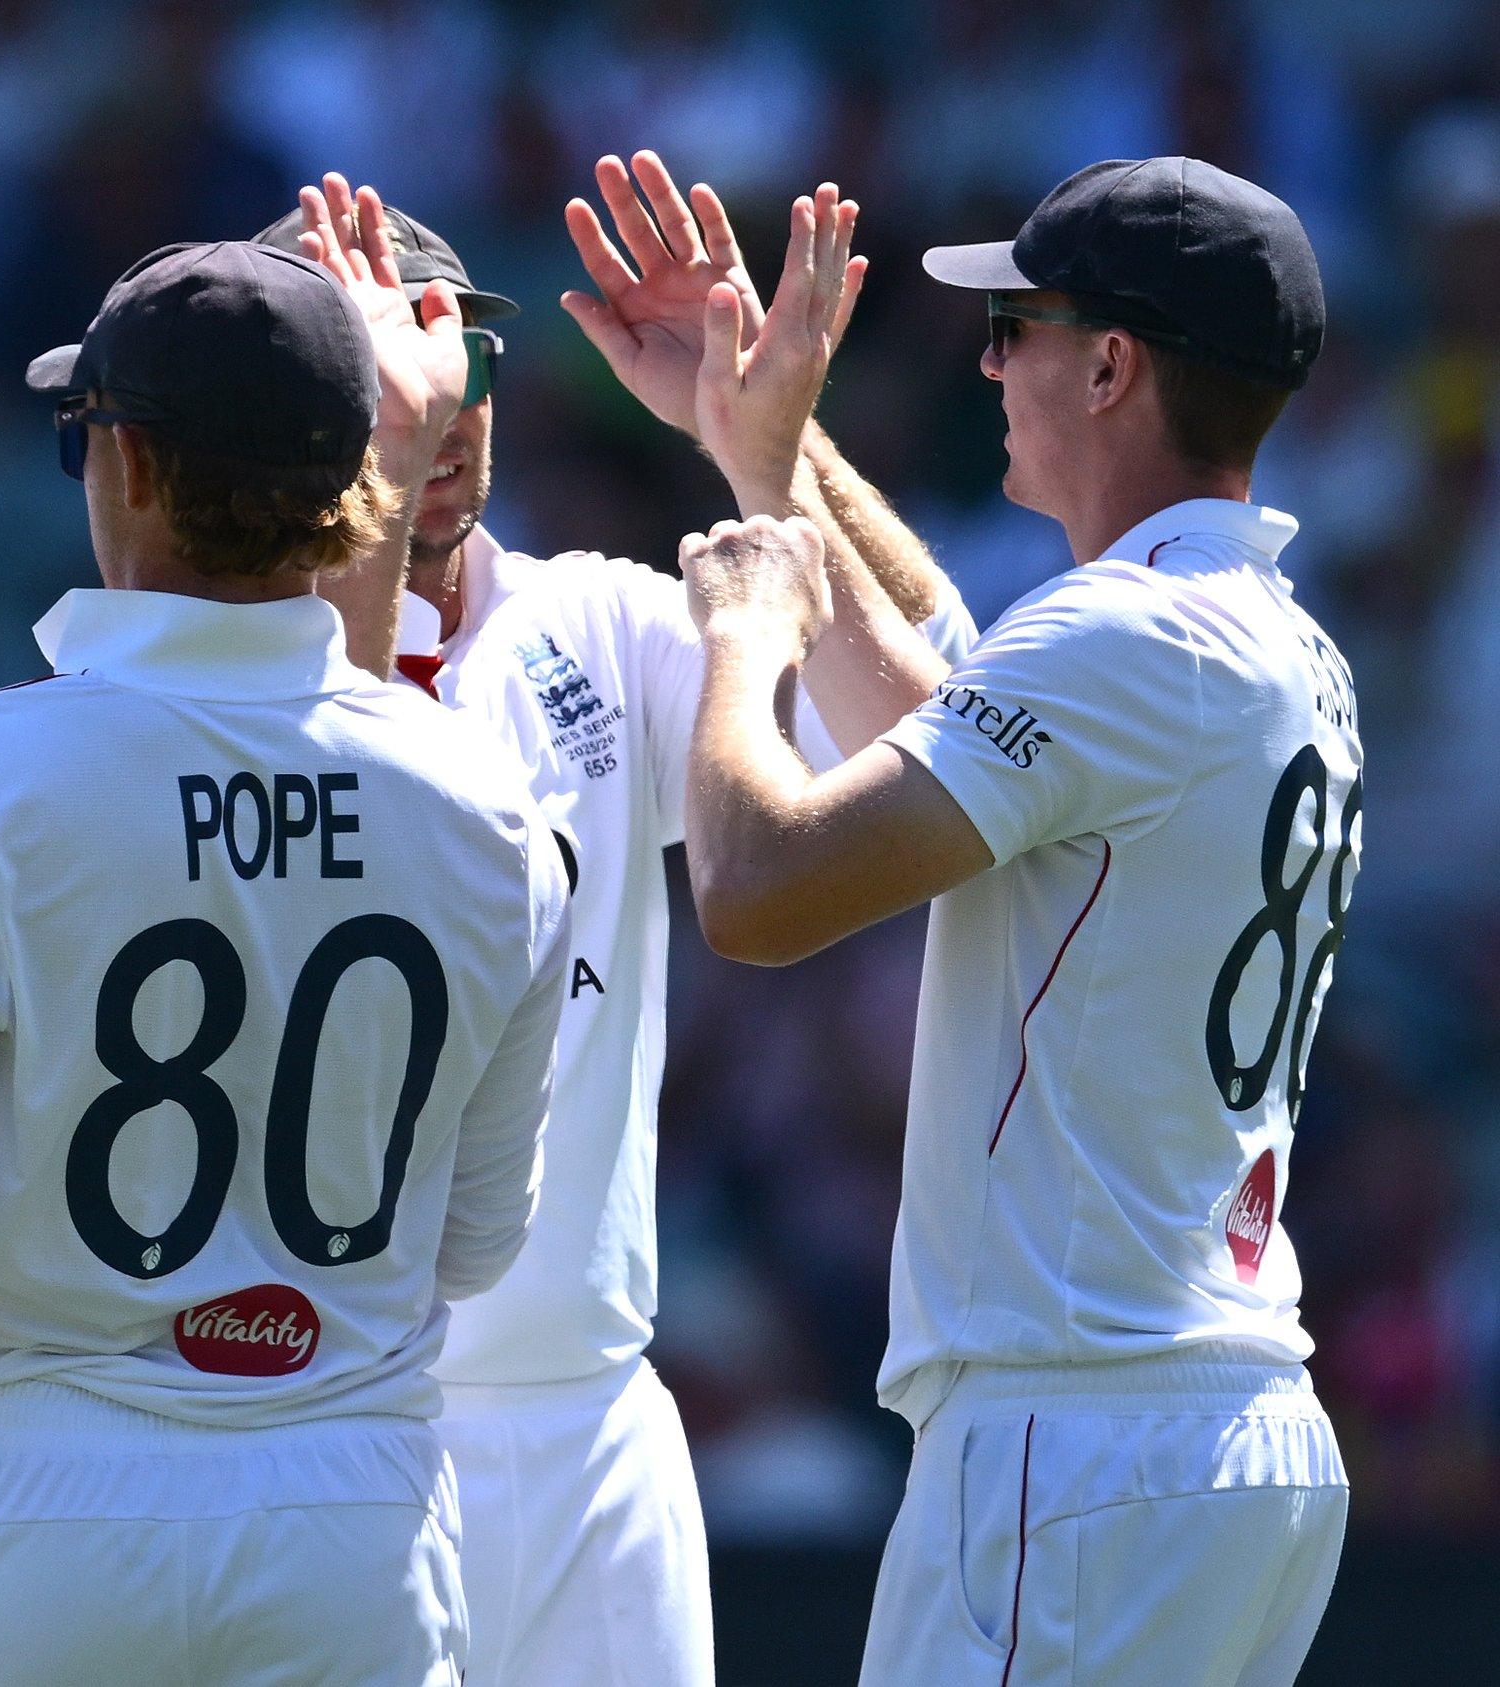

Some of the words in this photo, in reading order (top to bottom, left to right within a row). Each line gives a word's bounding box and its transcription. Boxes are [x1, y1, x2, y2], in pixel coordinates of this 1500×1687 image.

[584, 753, 616, 780] 655
[178, 771, 364, 881] POPE
[66, 913, 449, 1280] 80
[183, 1304, 314, 1364] Vitality
